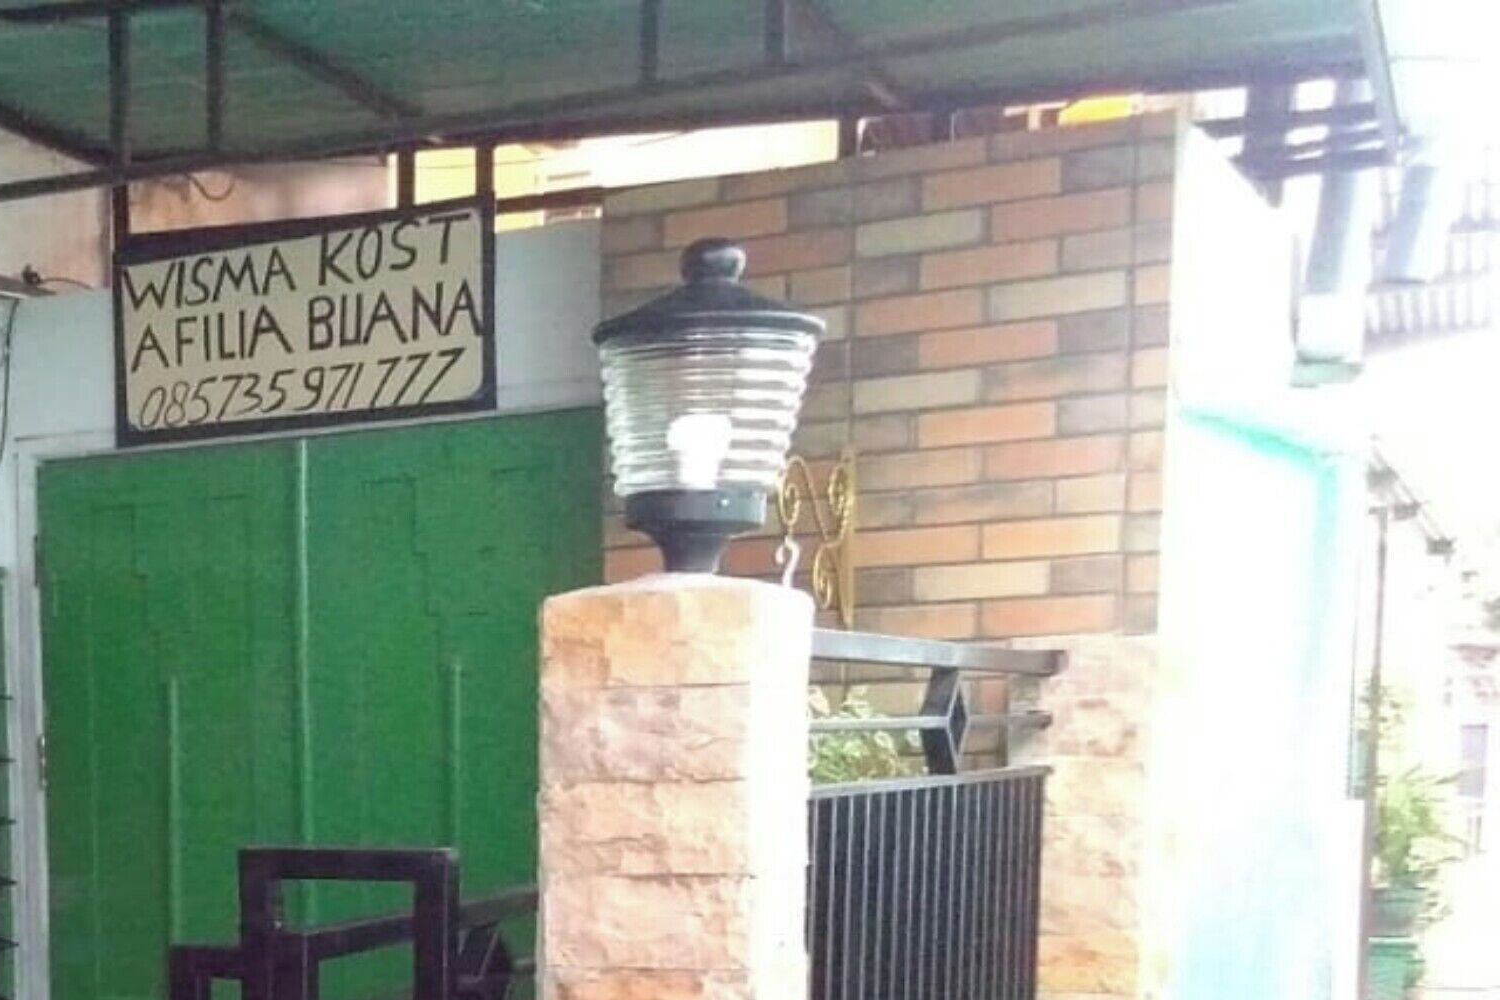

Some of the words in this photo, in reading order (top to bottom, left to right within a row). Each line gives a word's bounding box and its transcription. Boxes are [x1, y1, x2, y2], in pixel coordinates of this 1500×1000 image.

[123, 246, 296, 311] WISMA
[318, 212, 471, 287] KOST
[131, 304, 294, 373] AFILIA
[308, 278, 484, 351] BUANA
